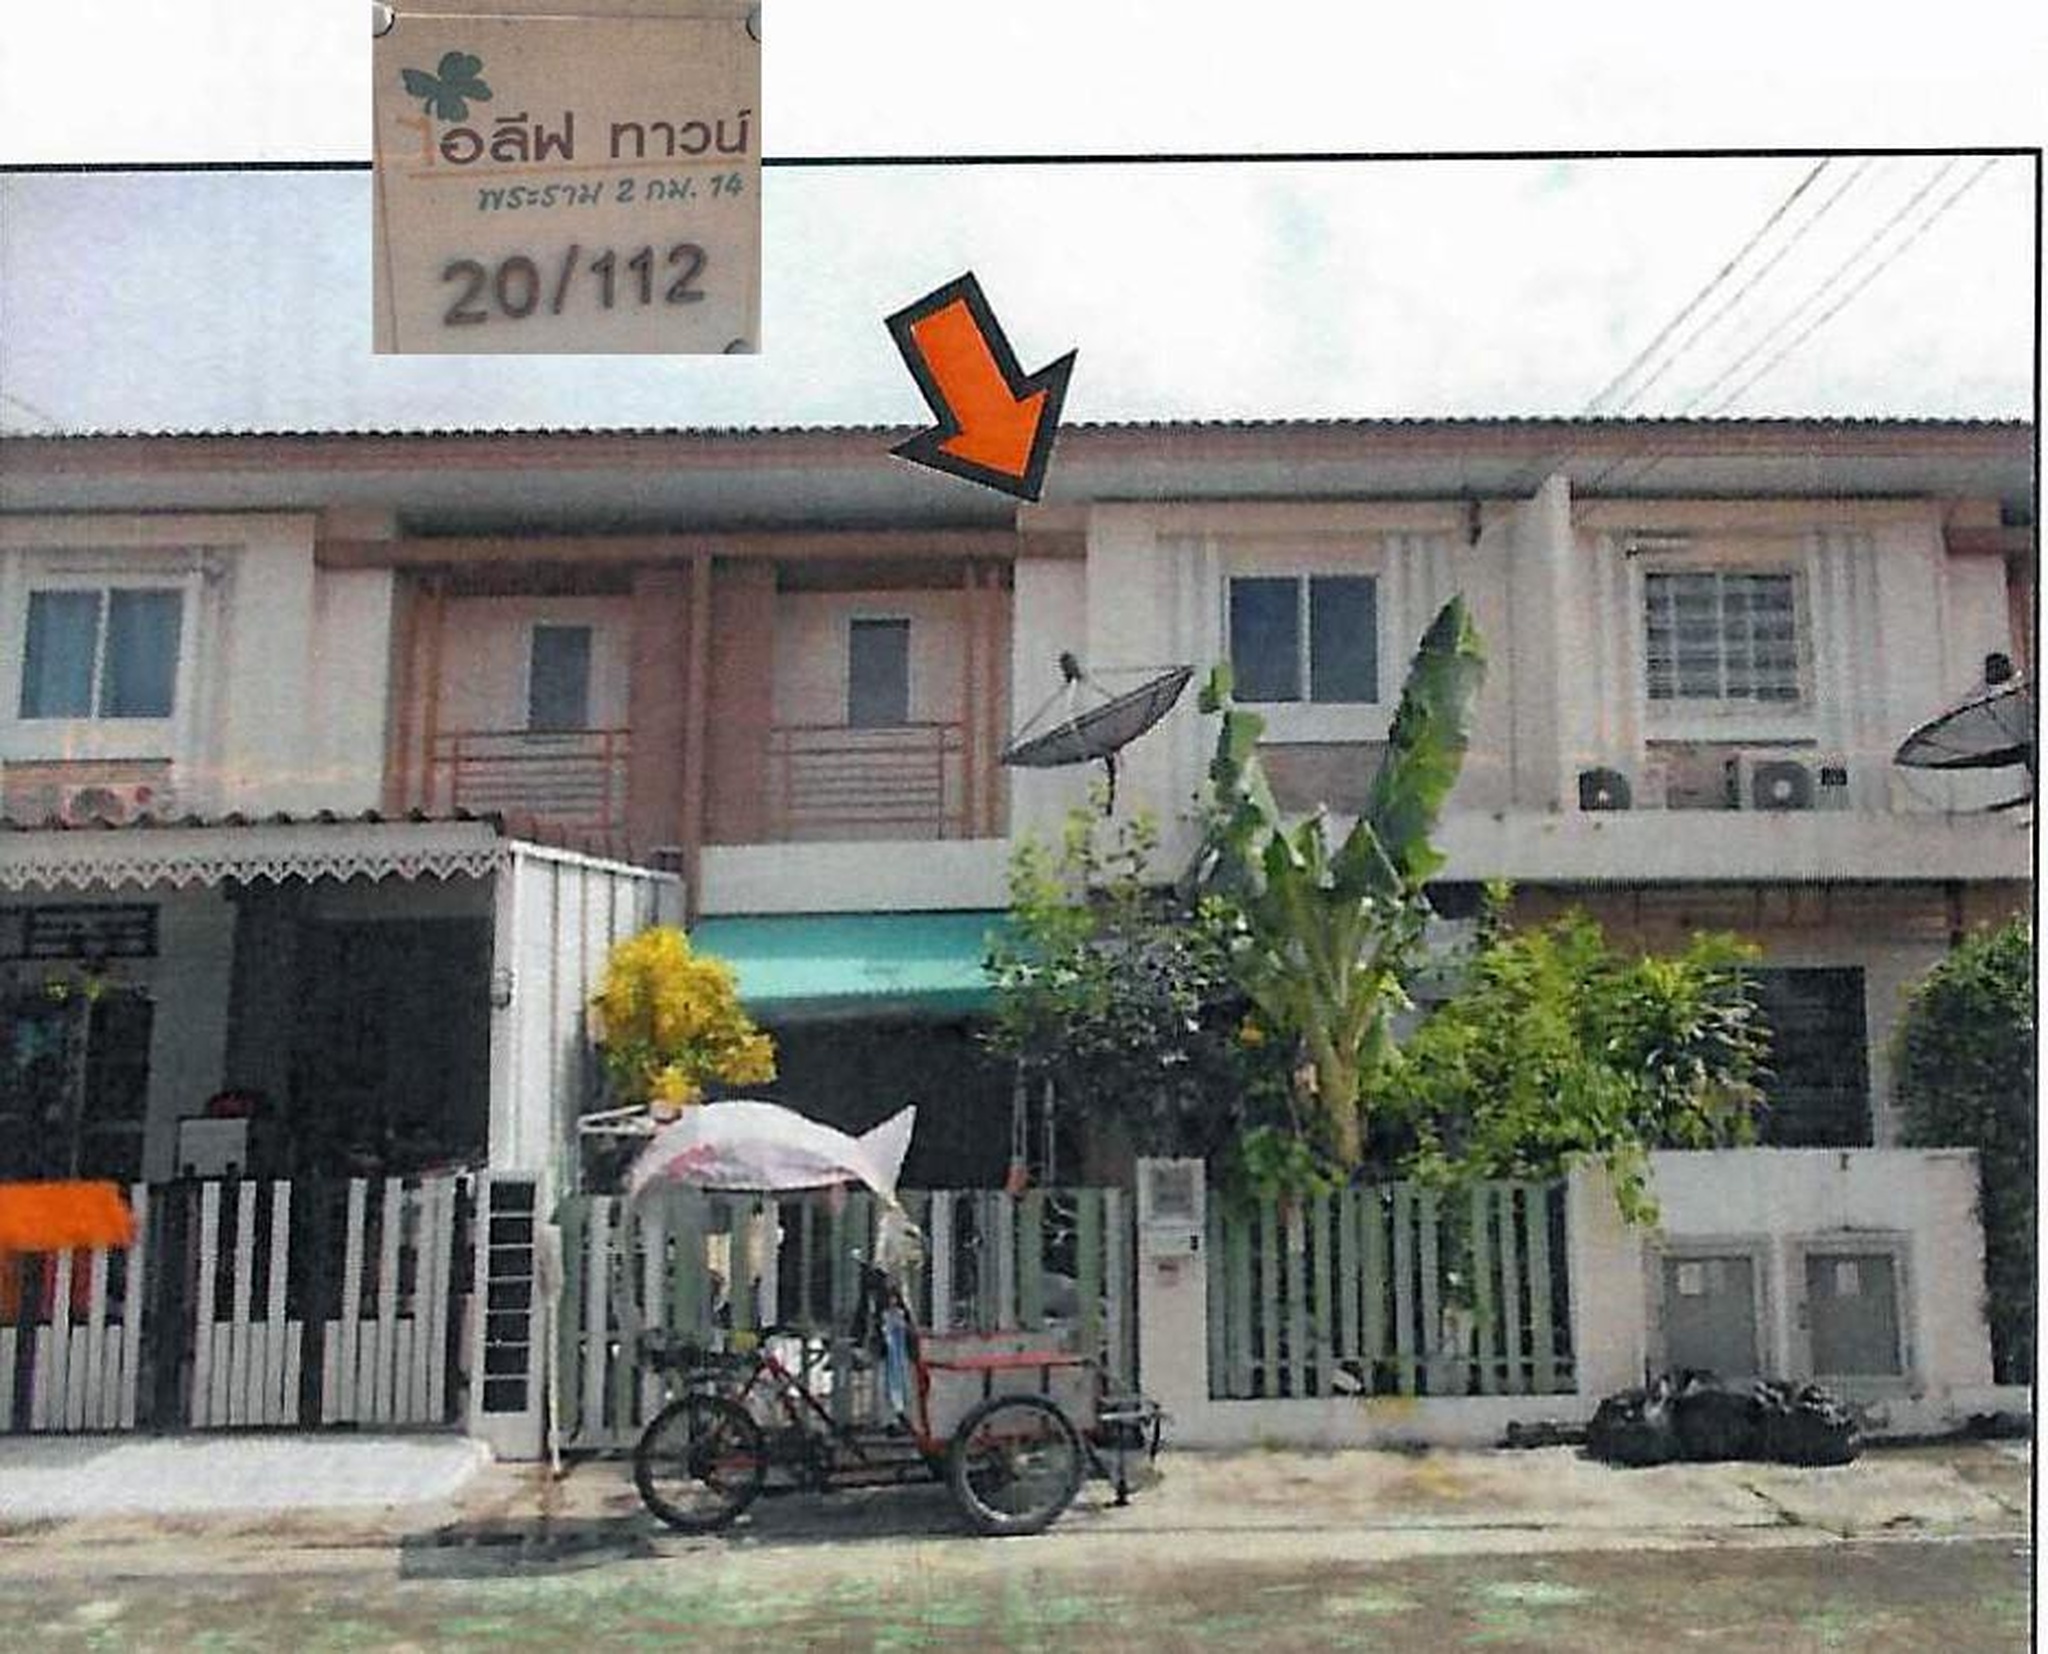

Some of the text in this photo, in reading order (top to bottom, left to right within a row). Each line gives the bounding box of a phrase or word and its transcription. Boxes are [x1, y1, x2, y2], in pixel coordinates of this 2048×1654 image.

[610, 108, 753, 159] ทาวน์
[477, 172, 745, 212] พระราม 2 กม. 14
[440, 243, 709, 327] 20/112
